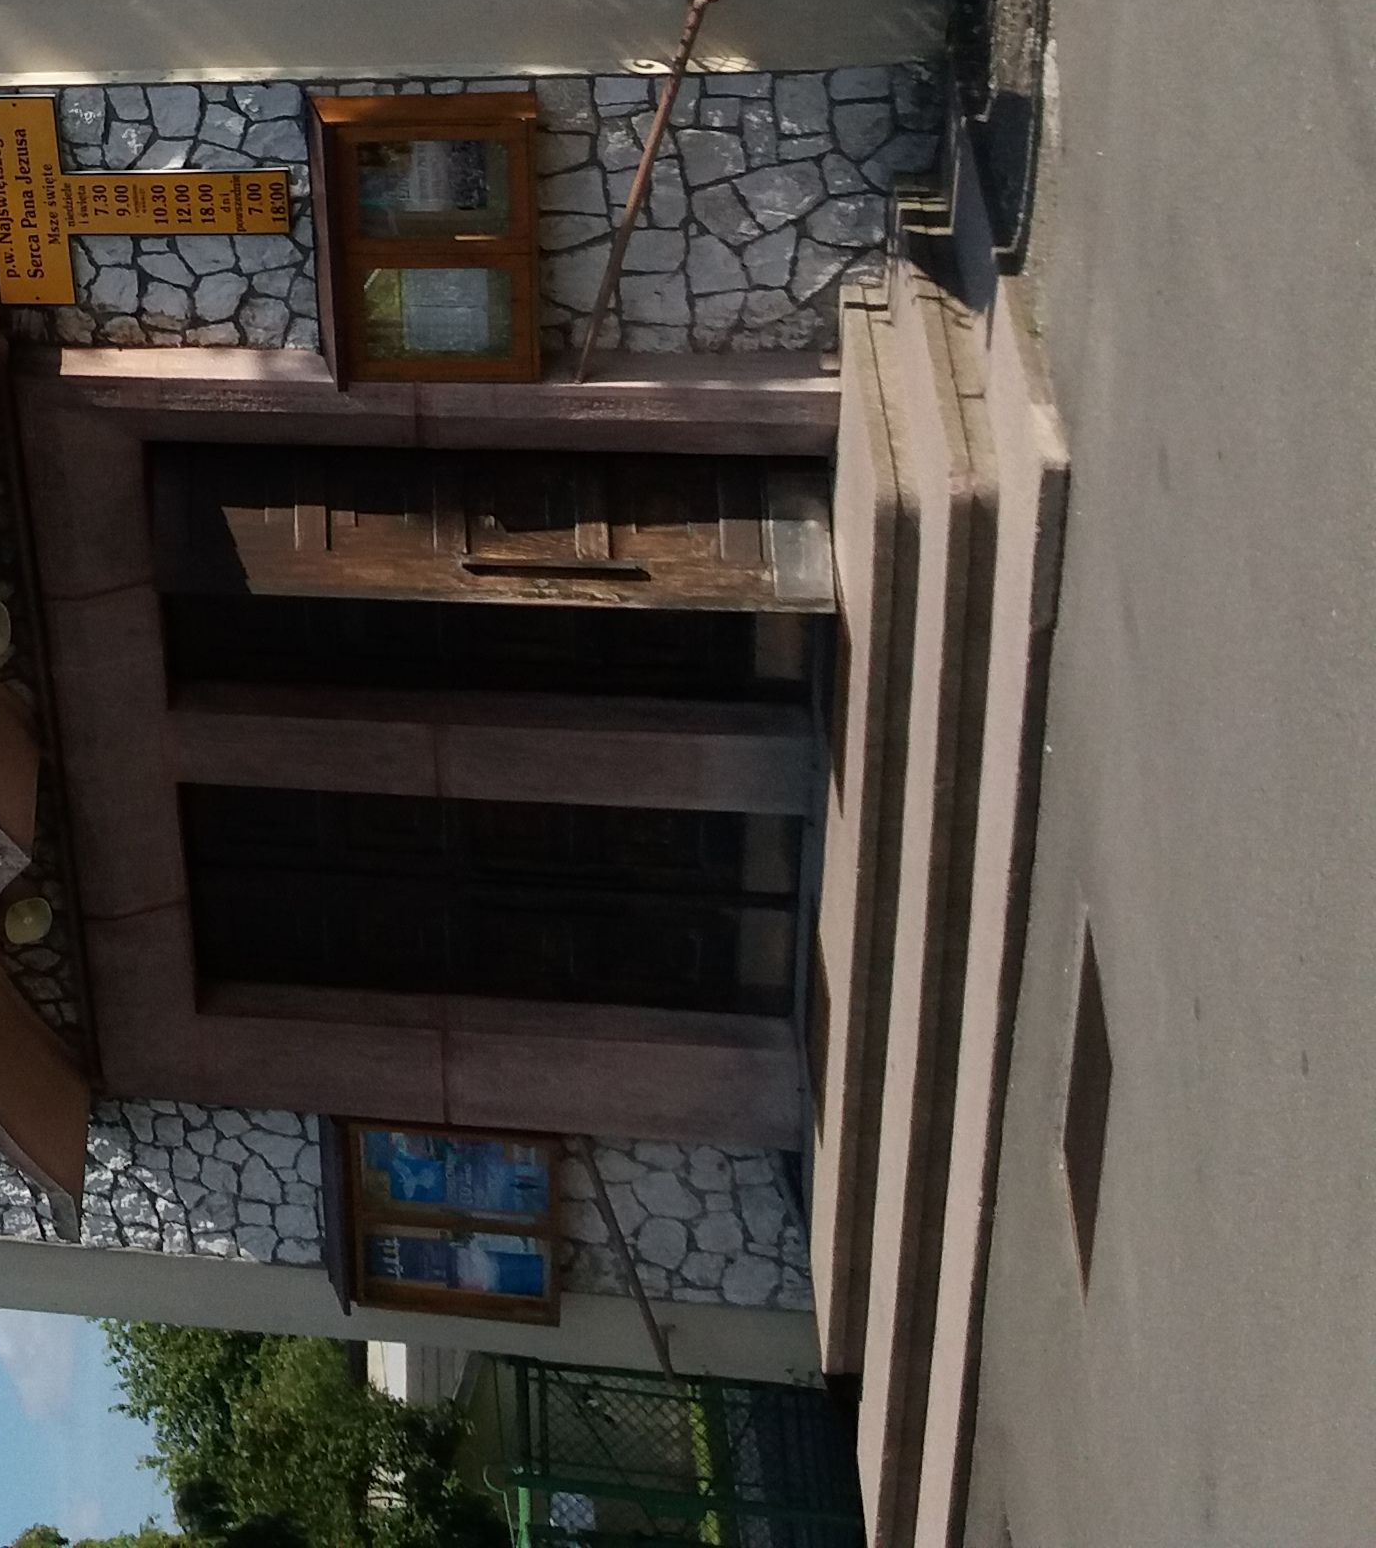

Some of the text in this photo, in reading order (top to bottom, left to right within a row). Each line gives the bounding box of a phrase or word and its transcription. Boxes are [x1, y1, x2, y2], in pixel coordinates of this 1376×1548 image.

[14, 128, 44, 278] Serca Pana Jezusa
[42, 164, 61, 245] Msze święte
[61, 183, 75, 227] niedziele
[91, 185, 109, 216] 7.30
[114, 185, 131, 217] 9.00
[150, 185, 169, 225] 10.30
[174, 184, 192, 224] 12.00
[198, 183, 216, 224] 18.00
[219, 193, 231, 213] dni
[230, 175, 247, 232] powszednie
[246, 183, 263, 215] 7.00
[4, 248, 21, 278] p.w.
